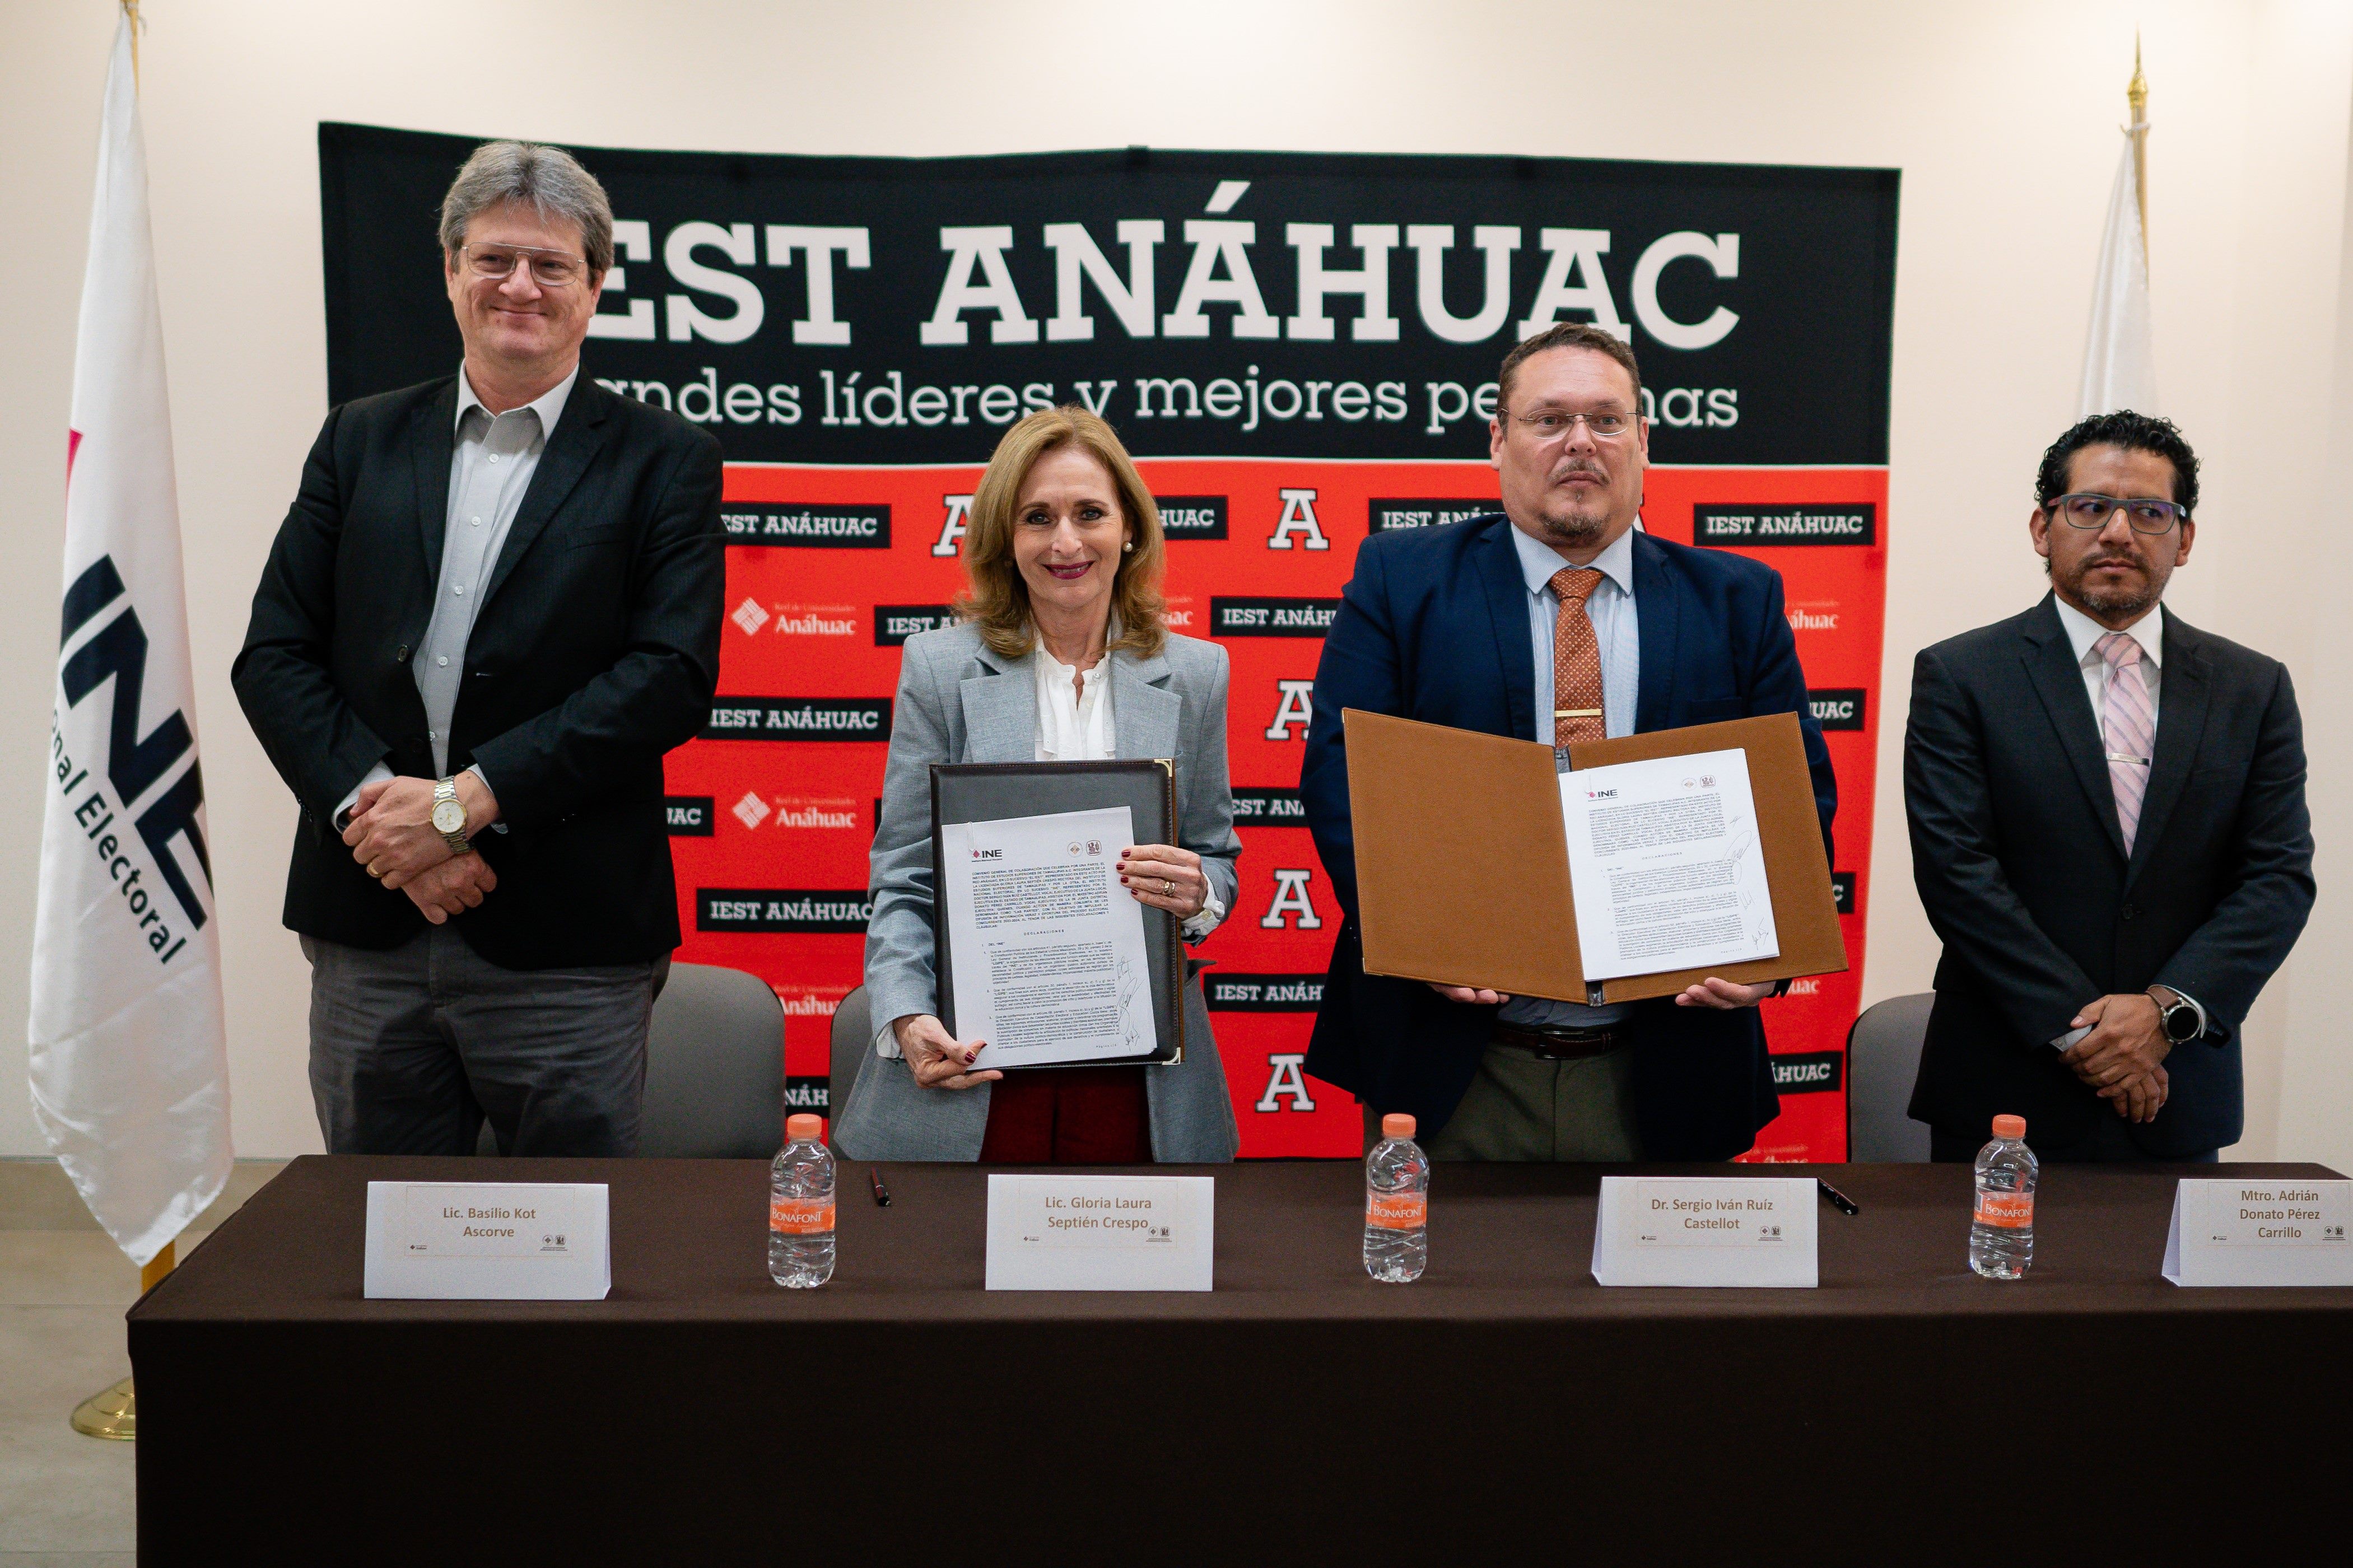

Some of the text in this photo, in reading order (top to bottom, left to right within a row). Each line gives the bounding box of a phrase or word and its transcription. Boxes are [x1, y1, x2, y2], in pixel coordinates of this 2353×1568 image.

[920, 180, 1741, 349] ANÁHUAC
[819, 370, 1056, 427] líderes
[1135, 365, 1408, 432] mejores
[763, 511, 877, 536] ANÁHUAC
[1268, 488, 1330, 550] A
[1381, 511, 1432, 529] IEST
[1705, 512, 1863, 536] IEST ANÁHUAC
[775, 613, 857, 636] Anáhuac
[887, 617, 934, 634] IEST
[1223, 608, 1269, 626] IEST
[709, 705, 879, 730] IEST ANÁHUAC
[1597, 789, 1618, 798] INE
[775, 805, 857, 829] Anáhuac
[981, 849, 1003, 858] INE
[75, 791, 187, 965] Electoral
[1261, 870, 1321, 930] A
[710, 900, 761, 920] IEST
[1215, 984, 1261, 1001] IEST
[1255, 1054, 1316, 1113] A
[1045, 1196, 1152, 1209] Lic. Gloria Laura
[2241, 1189, 2319, 1201] Mtro. Adrián
[443, 1207, 537, 1219] Lic. Basilio Kot
[1374, 1205, 1423, 1218] BONAFONT
[1651, 1198, 1773, 1213] Dr. Sergio Iván Ruíz
[2240, 1208, 2321, 1220] Donato Pérez
[772, 1207, 823, 1223] BONAFONT
[1048, 1216, 1149, 1230] Septién Crespo
[1684, 1217, 1740, 1229] Castellot
[463, 1226, 515, 1237] Ascorve
[2258, 1226, 2302, 1238] Carrillo
